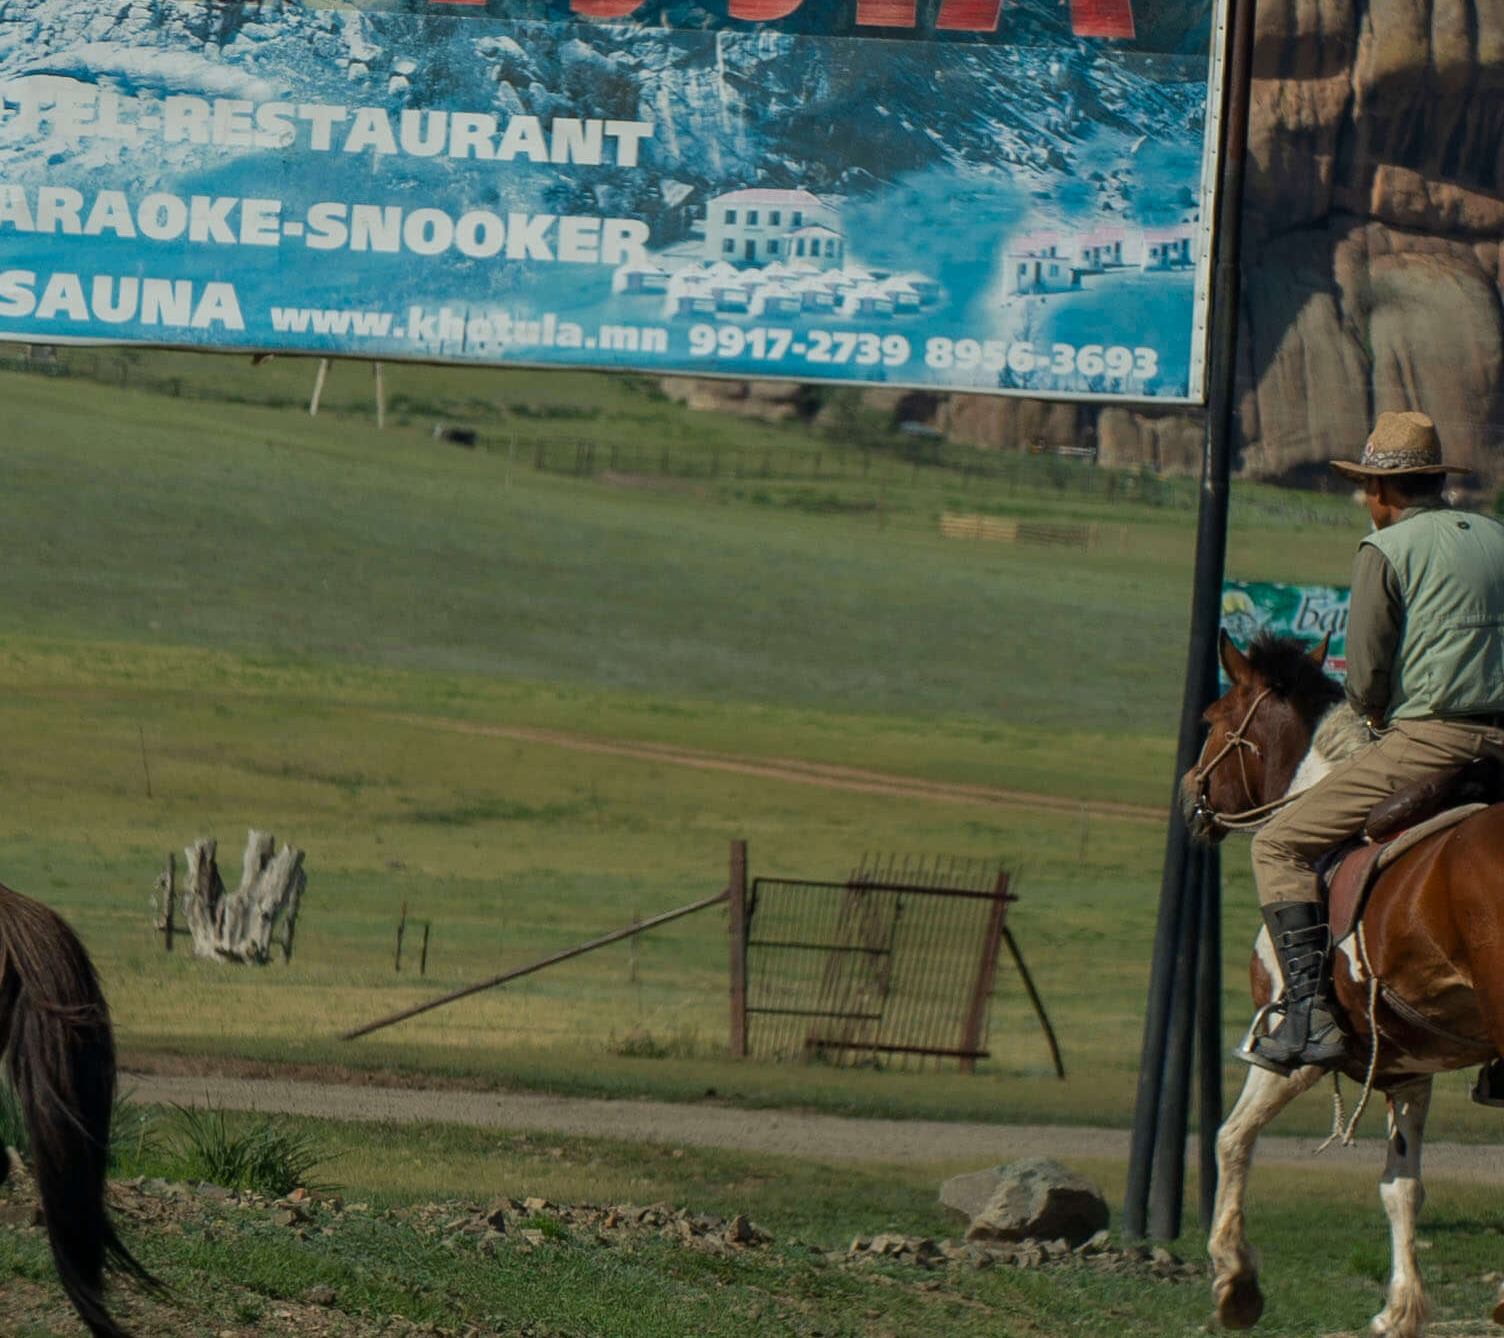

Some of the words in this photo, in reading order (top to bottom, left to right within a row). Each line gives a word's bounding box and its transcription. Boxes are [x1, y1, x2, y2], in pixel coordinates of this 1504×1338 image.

[270, 305, 669, 353] www.khotula.mn
[688, 325, 910, 367] 9917-2739
[924, 336, 1159, 380] 8956-3693
